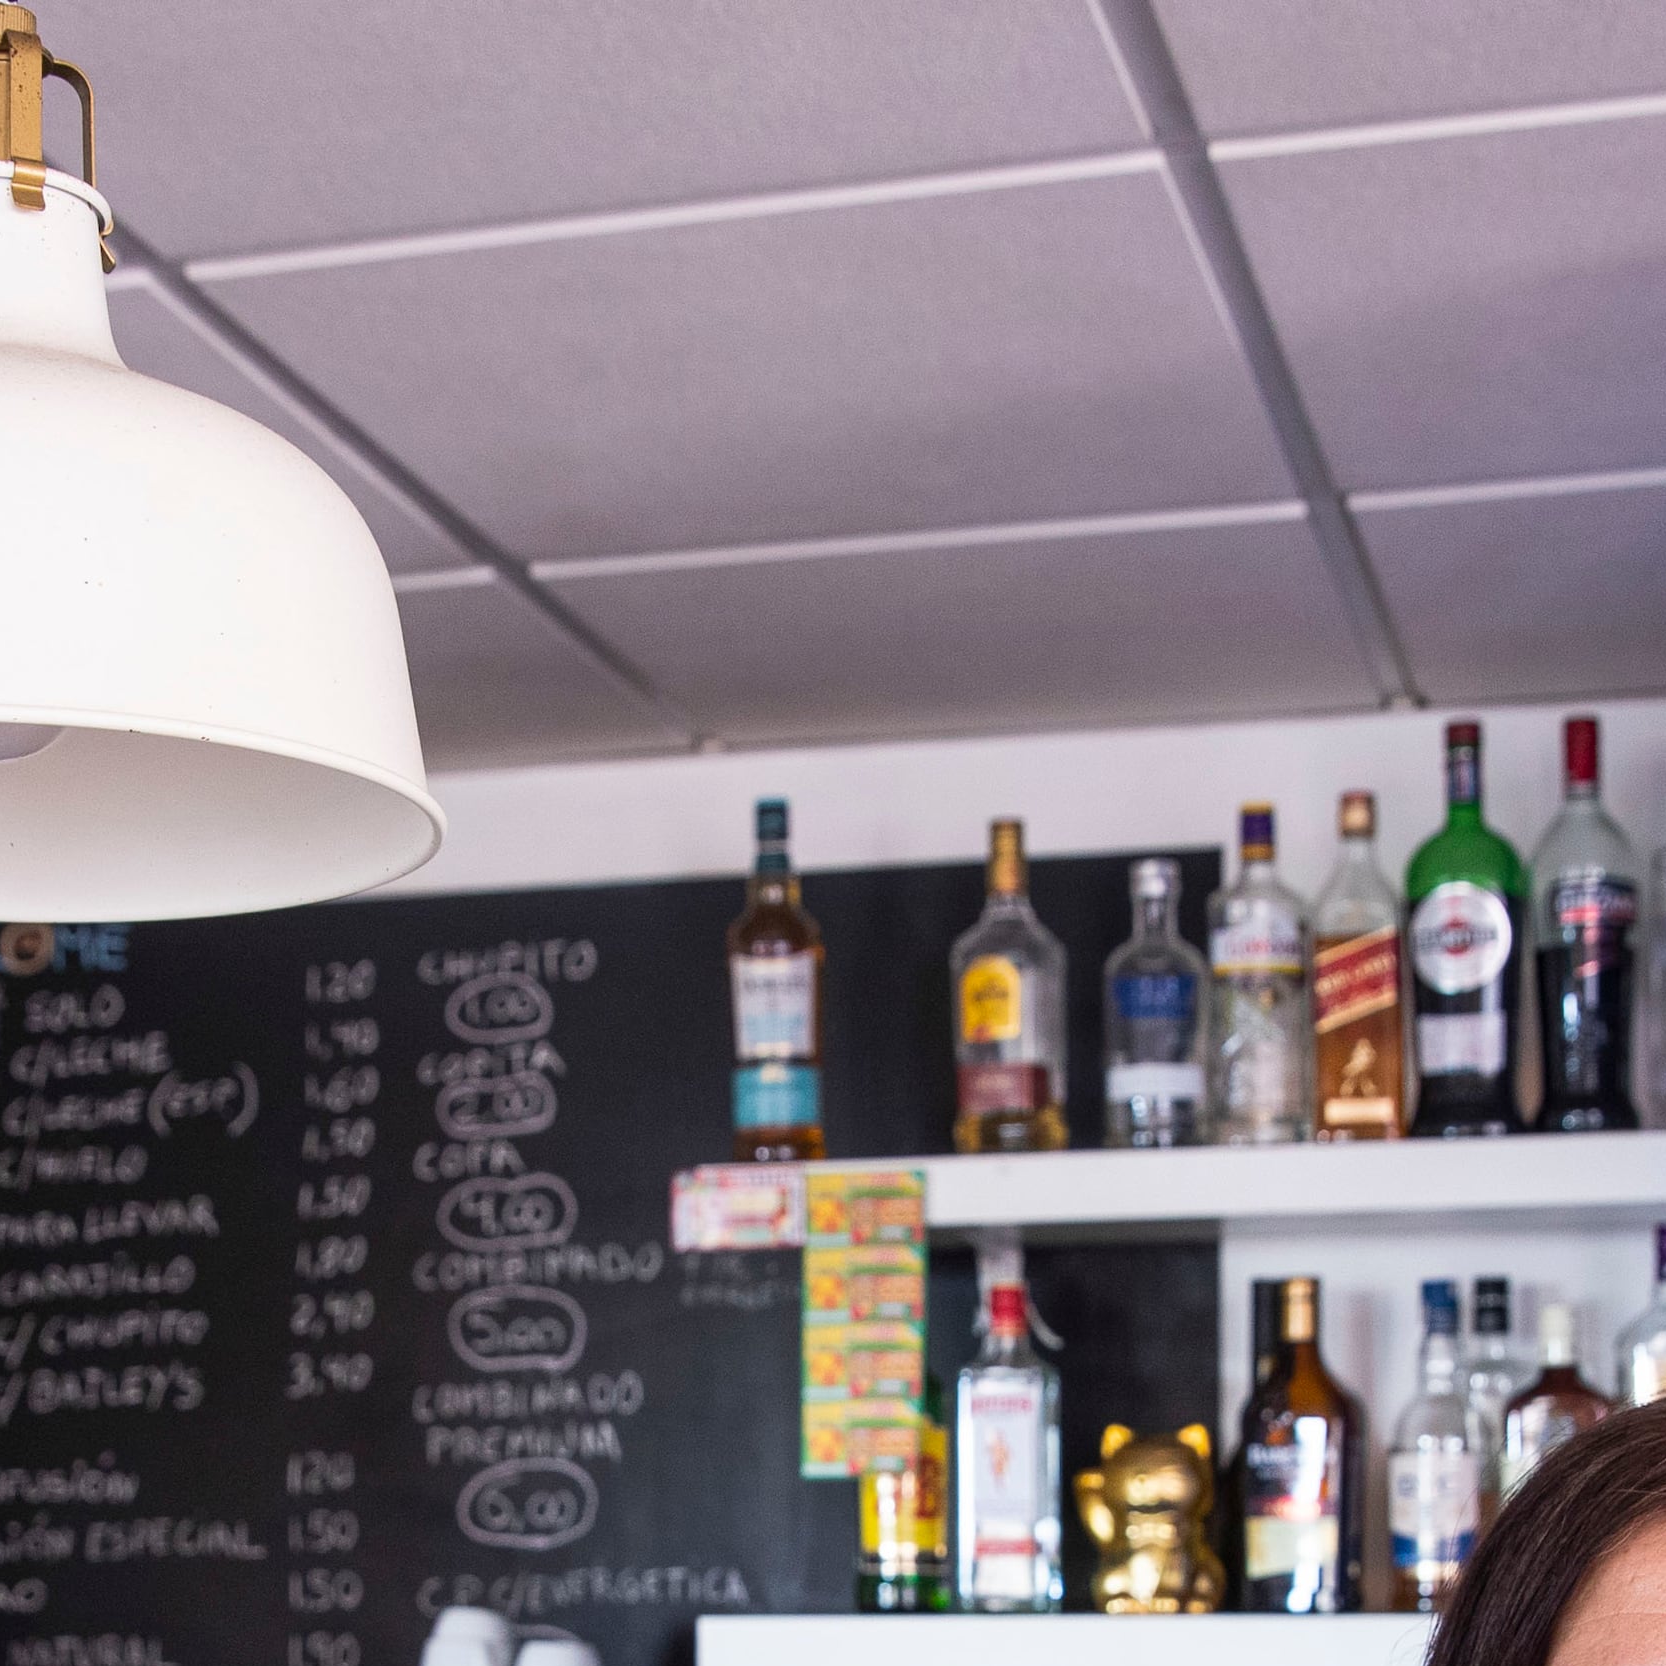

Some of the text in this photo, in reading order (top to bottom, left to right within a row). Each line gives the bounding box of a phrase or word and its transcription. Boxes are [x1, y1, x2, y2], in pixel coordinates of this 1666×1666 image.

[24, 984, 126, 1034] SOLO
[413, 1137, 528, 1183] COPA
[81, 1193, 220, 1244] LLEVAR
[412, 1368, 645, 1424] COMBINADO
[426, 1419, 623, 1465] PREMIUM
[83, 1515, 269, 1564] ESPECIAL
